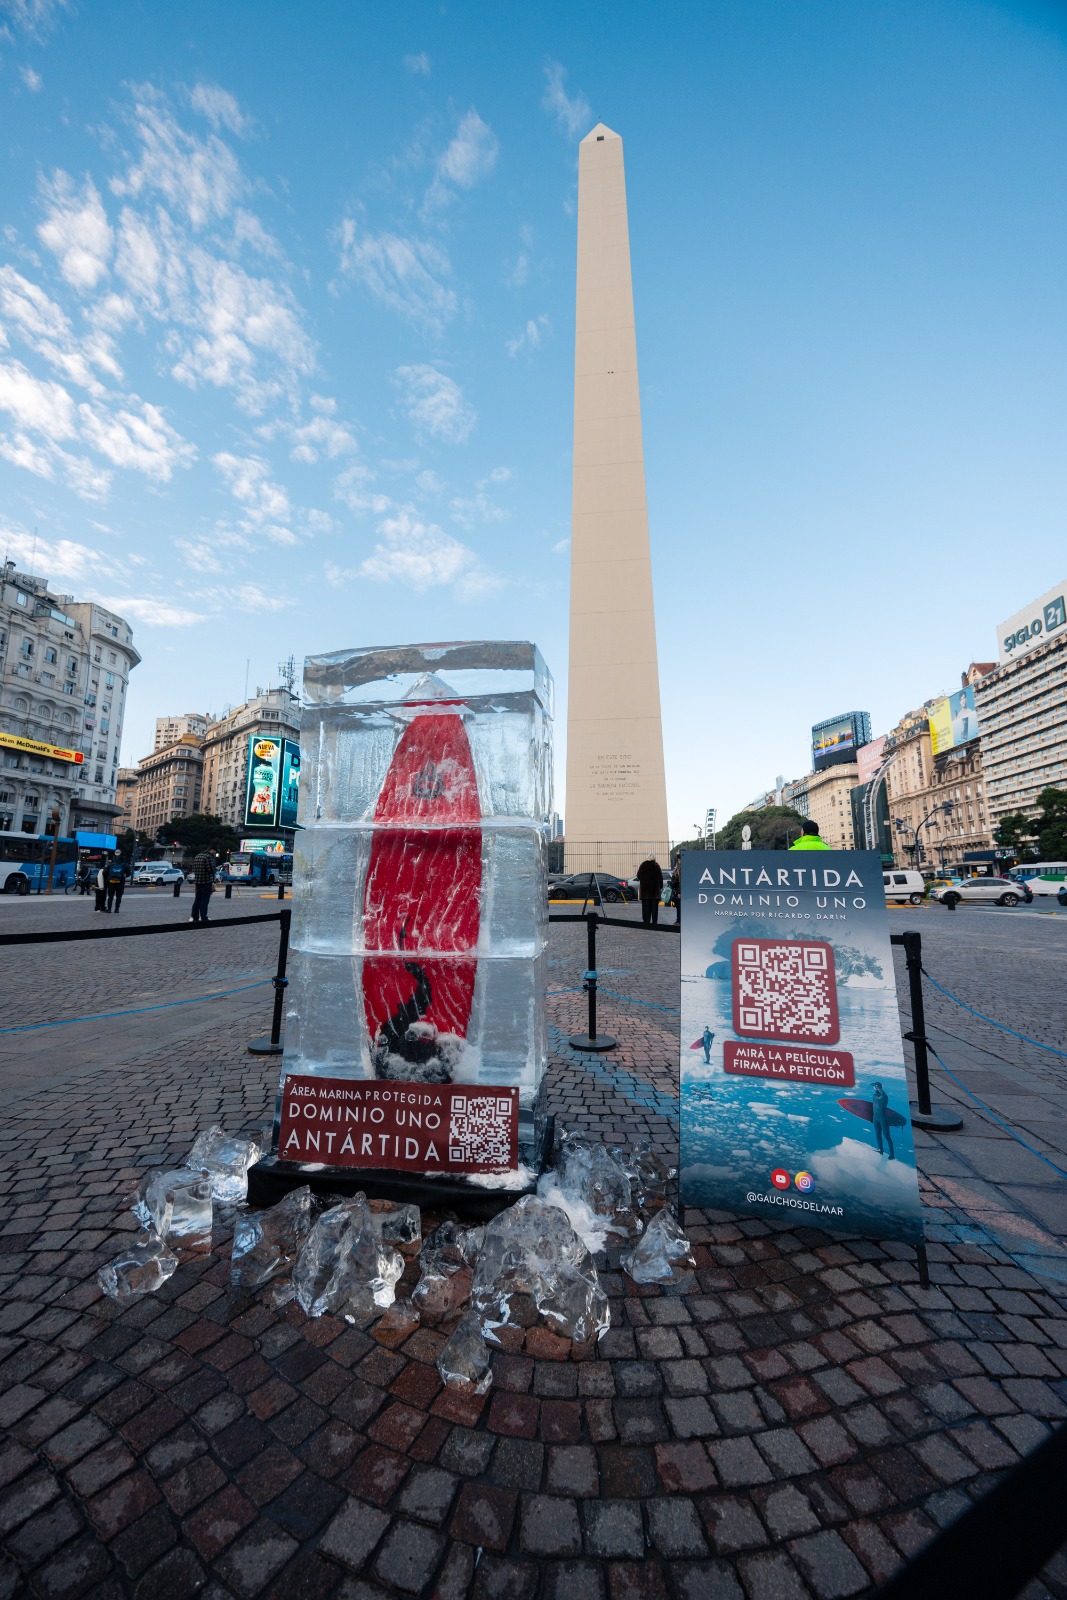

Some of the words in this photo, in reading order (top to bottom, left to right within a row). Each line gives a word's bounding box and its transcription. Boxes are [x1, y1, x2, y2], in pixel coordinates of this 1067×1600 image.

[1004, 619, 1042, 652] SIGLO
[1047, 607, 1061, 625] 21
[16, 740, 50, 753] McDonald's
[699, 866, 864, 887] ANTÁRTIDA
[698, 893, 799, 907] DOMINIO
[816, 897, 867, 910] UNO
[736, 1047, 765, 1058] MIRÁ
[768, 1050, 782, 1061] LA
[785, 1051, 840, 1067] PELÍCULA
[733, 1059, 769, 1072] FIRMÁ
[772, 1063, 786, 1073] LA
[789, 1065, 845, 1080] PETICIÓN
[289, 1083, 316, 1098] ÁREA
[319, 1088, 362, 1100] MARINA
[365, 1091, 442, 1106] PROTEGIDA
[289, 1102, 385, 1124] DOMINIO
[395, 1110, 441, 1129] UNO
[285, 1127, 440, 1162] ANTÁRTIDA
[746, 1192, 844, 1216] @GAUCHOSDELMAR
